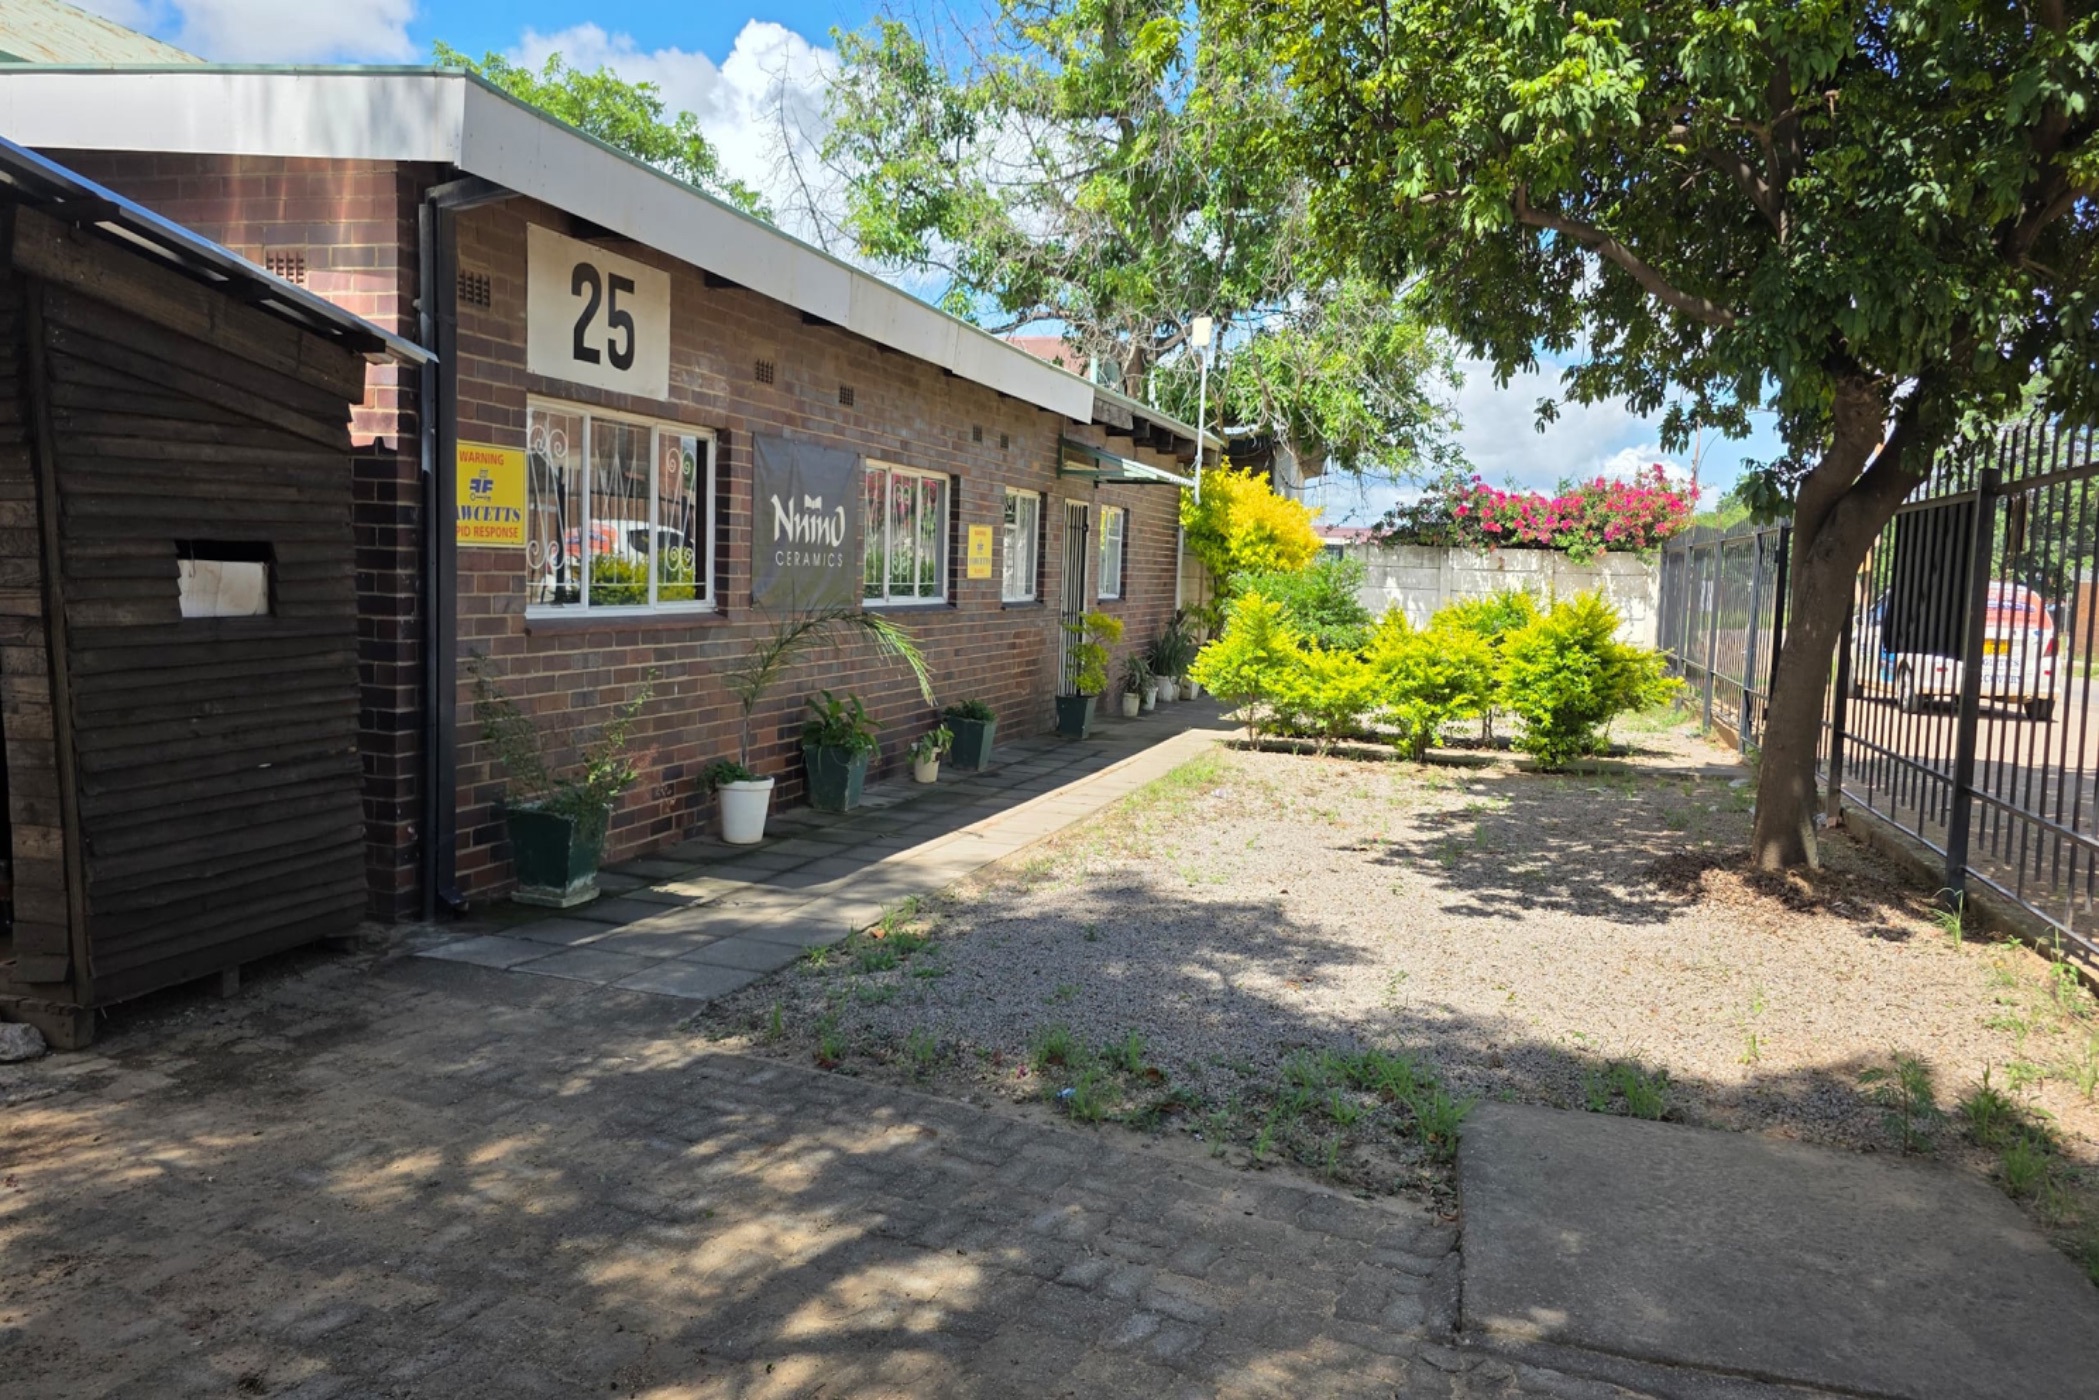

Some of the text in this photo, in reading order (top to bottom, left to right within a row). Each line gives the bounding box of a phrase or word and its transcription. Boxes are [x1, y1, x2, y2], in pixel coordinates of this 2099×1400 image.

[571, 262, 635, 371] 25
[459, 450, 504, 466] WARNING
[473, 526, 518, 539] RESPONSE
[775, 550, 843, 568] CERAMICS
